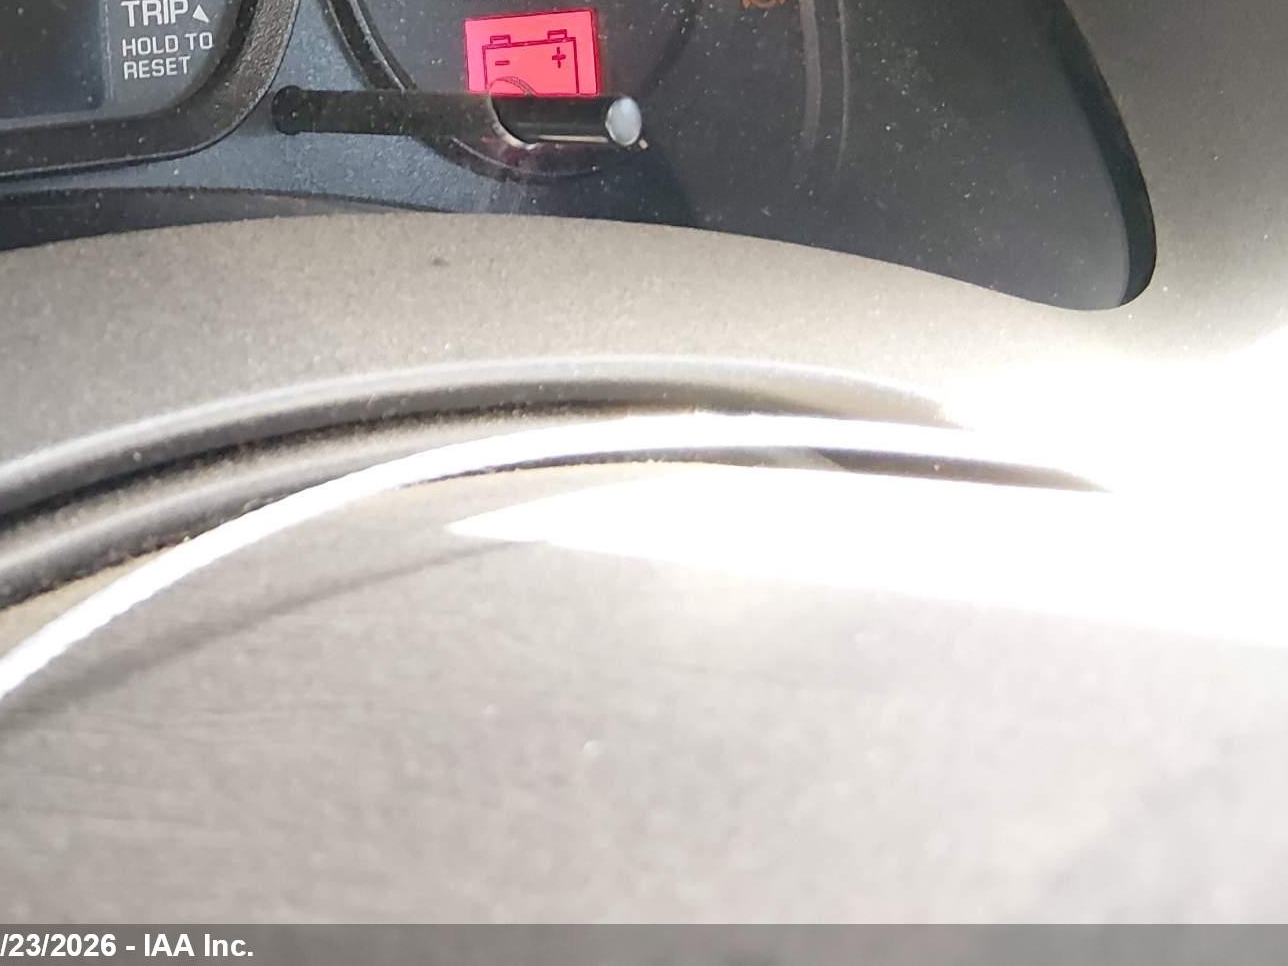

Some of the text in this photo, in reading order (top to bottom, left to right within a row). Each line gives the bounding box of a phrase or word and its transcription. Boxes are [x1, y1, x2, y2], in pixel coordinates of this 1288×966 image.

[121, 32, 213, 58] HOLD TO
[123, 57, 191, 80] RESET
